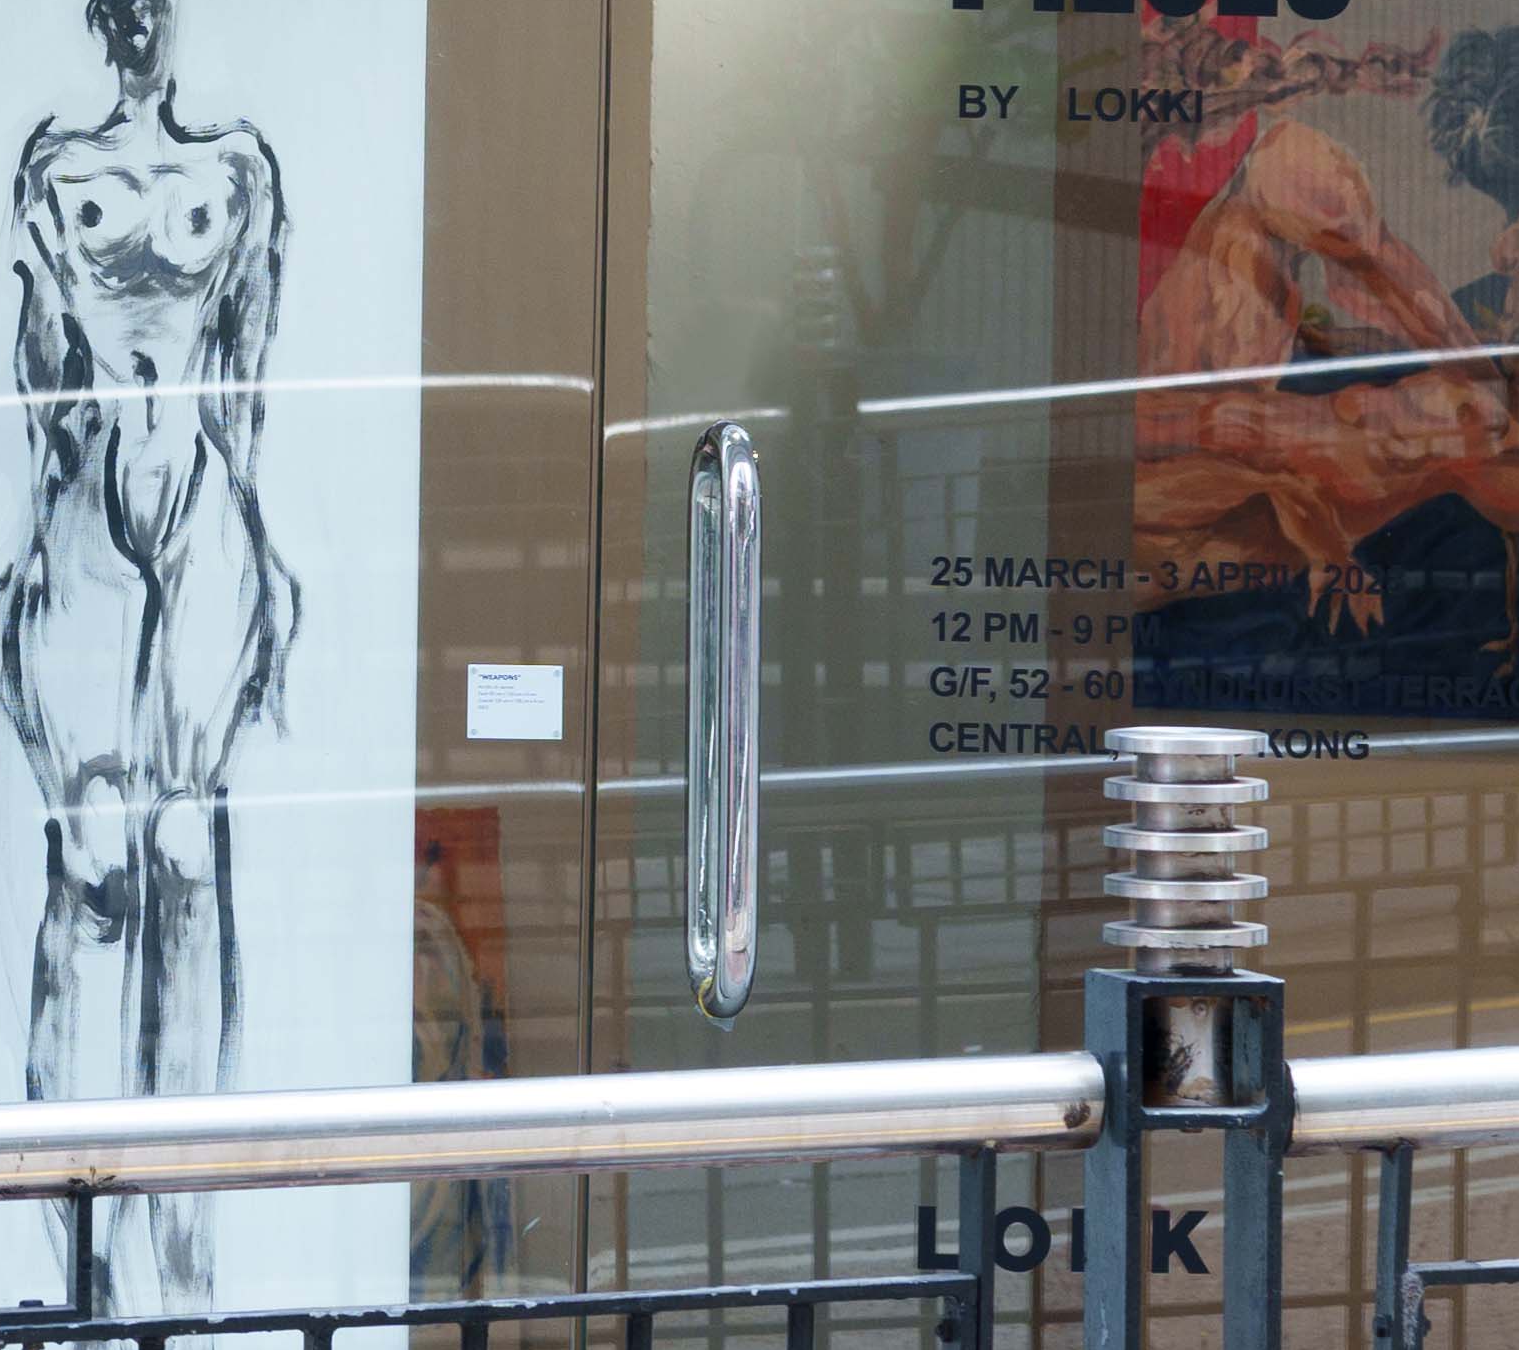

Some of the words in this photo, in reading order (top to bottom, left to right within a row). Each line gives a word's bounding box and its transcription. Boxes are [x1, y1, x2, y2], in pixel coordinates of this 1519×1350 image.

[958, 85, 1019, 120] BY
[1067, 87, 1204, 124] LOKKI
[931, 556, 973, 587] 25
[985, 557, 1125, 589] MARCH
[1160, 561, 1179, 591] 3
[932, 612, 971, 642] 12
[984, 613, 1039, 644] PM
[1073, 615, 1093, 645] 9
[1106, 616, 1162, 647] PM
[929, 666, 997, 703] G/F,
[1009, 669, 1050, 699] 52
[1084, 670, 1125, 700] 60
[929, 722, 1119, 761] CENTRAL,
